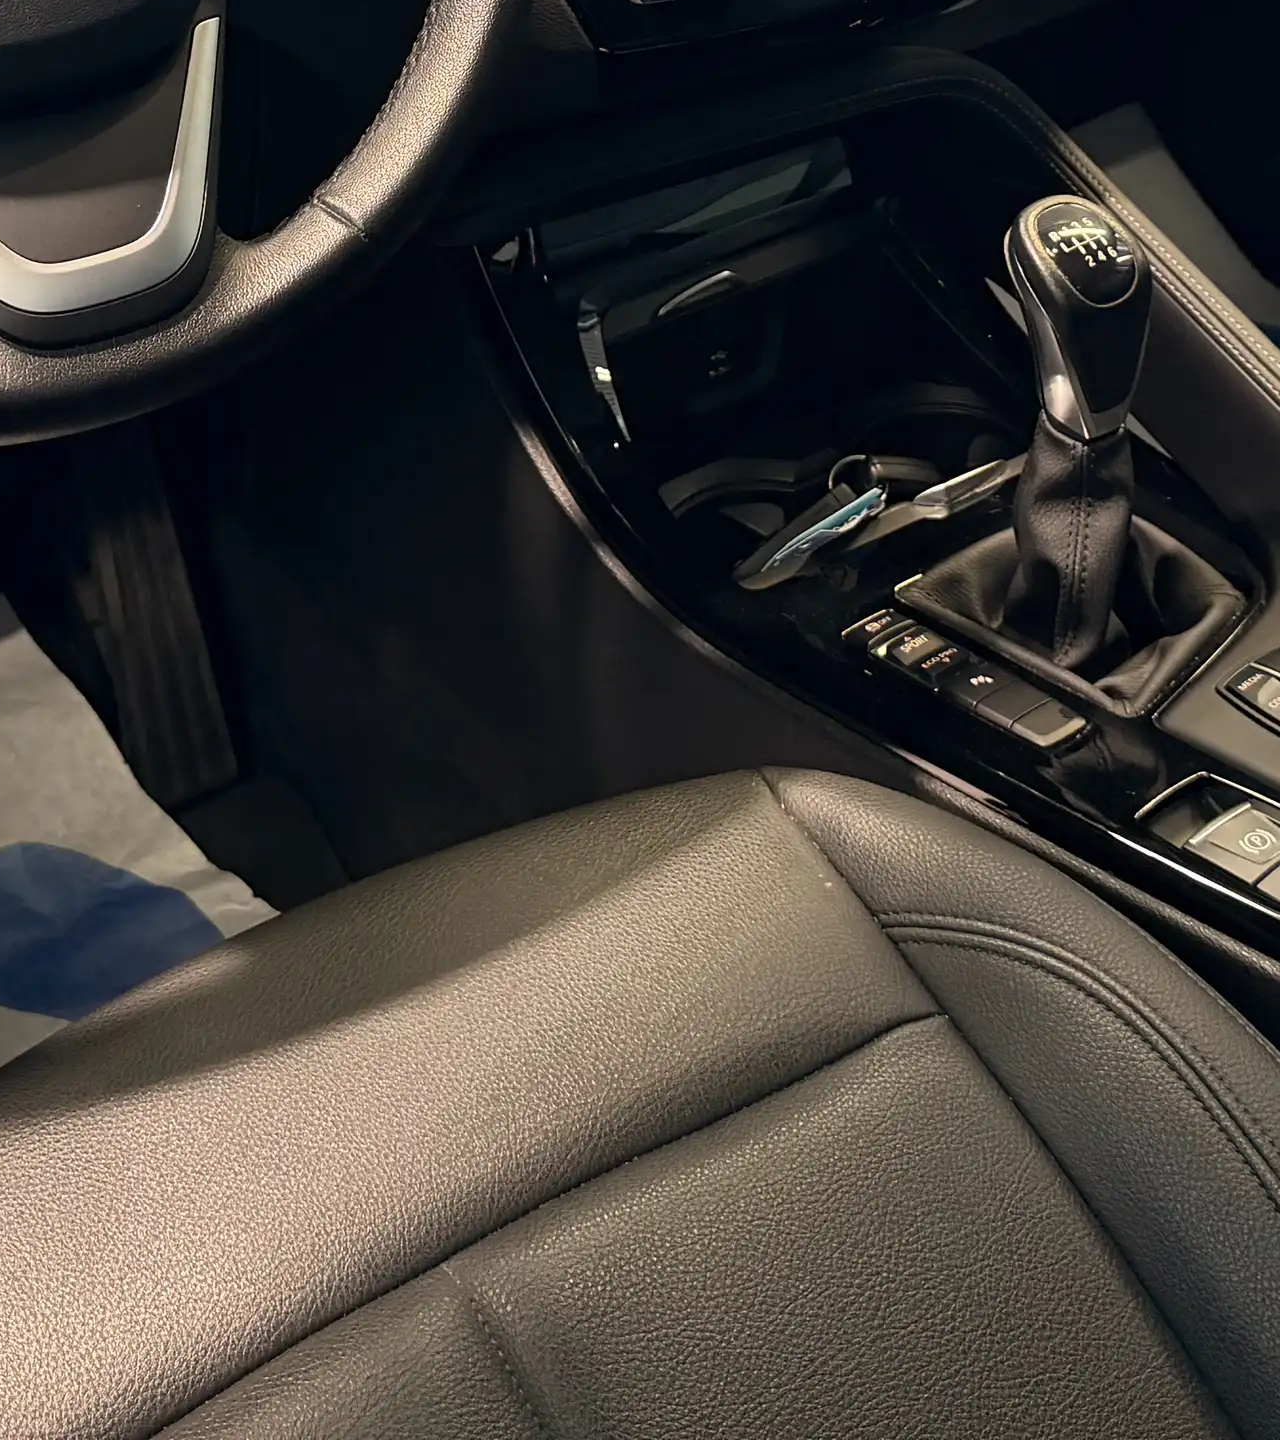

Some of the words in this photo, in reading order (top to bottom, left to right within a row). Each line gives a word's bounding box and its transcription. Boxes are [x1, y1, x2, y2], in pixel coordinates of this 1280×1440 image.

[1084, 255, 1097, 268] 2
[1097, 250, 1107, 261] 4
[1107, 246, 1118, 258] 6
[899, 634, 929, 654] SPORT
[1237, 672, 1266, 691] MEDIA
